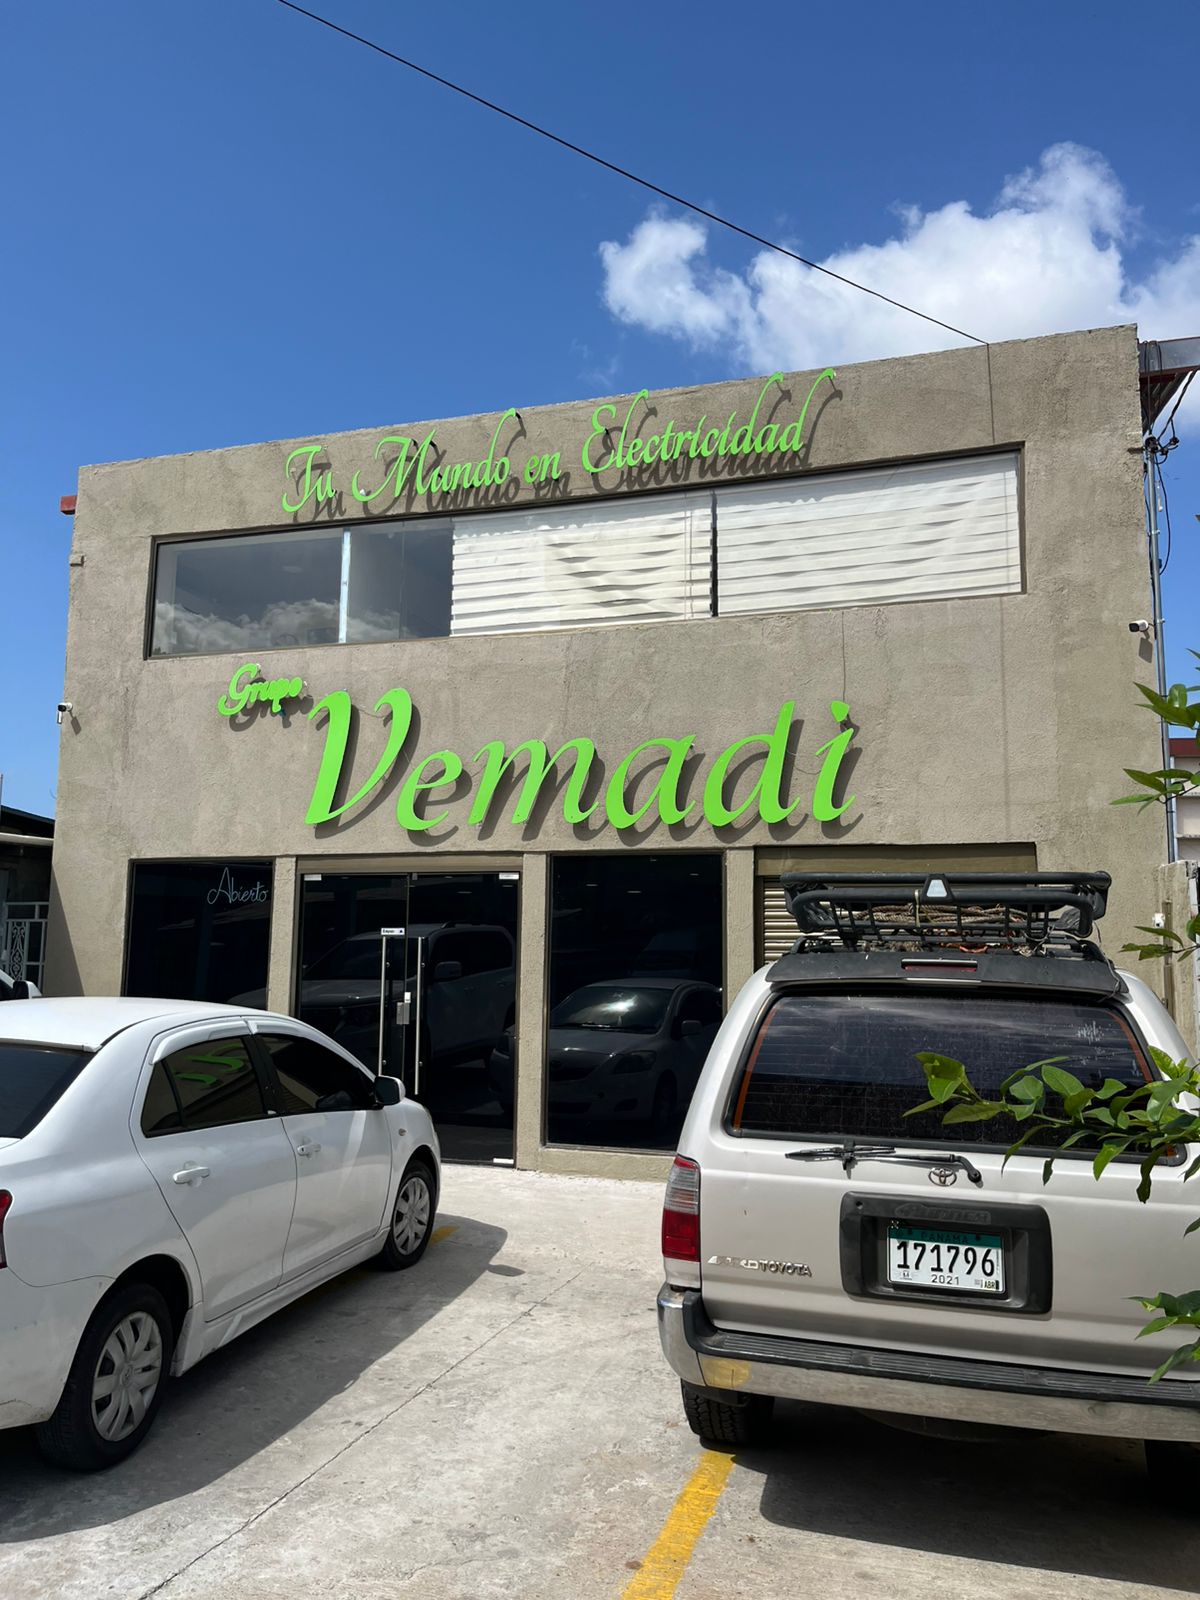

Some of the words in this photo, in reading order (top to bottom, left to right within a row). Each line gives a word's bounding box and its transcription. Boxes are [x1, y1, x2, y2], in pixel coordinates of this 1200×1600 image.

[281, 445, 337, 513] Tu
[351, 408, 517, 503] Mundo
[523, 452, 561, 484] en
[581, 368, 836, 474] Electricidad
[216, 663, 303, 717] Grupo
[304, 687, 857, 832] Vemadi
[207, 866, 269, 905] Abierto
[759, 1259, 812, 1278] TOYOTA
[896, 1240, 995, 1277] 171796
[931, 1273, 960, 1286] 2021
